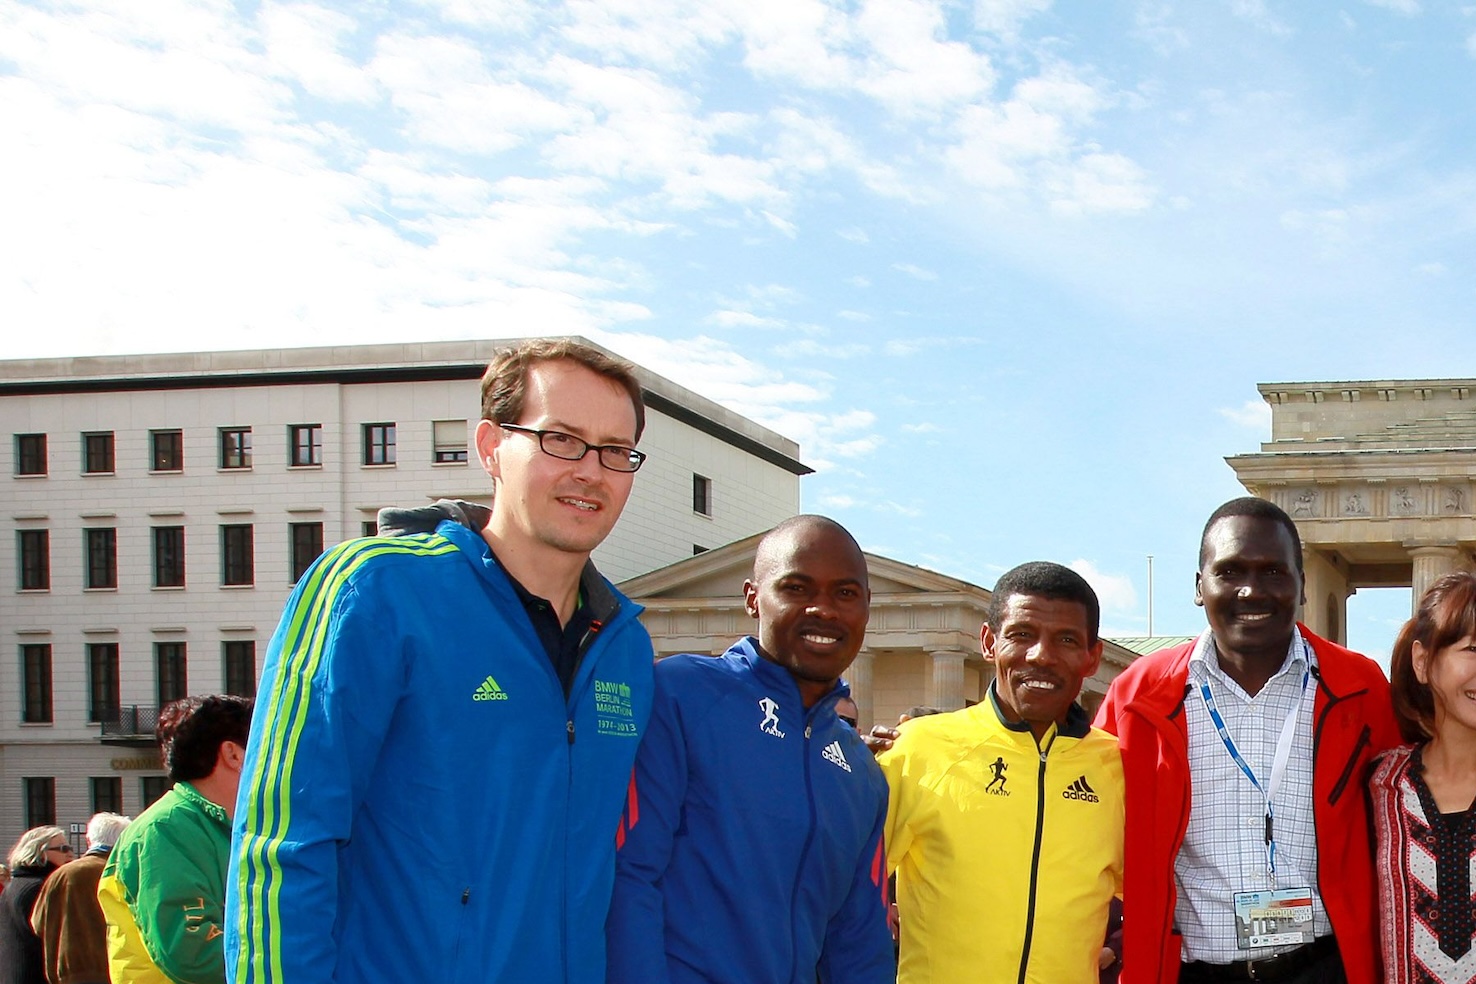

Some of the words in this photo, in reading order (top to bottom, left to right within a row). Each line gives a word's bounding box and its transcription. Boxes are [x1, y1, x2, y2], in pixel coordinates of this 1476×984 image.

[595, 680, 619, 694] BMW
[472, 691, 508, 701] adidas
[595, 693, 620, 704] BERLIN
[596, 703, 633, 717] MARATHON
[821, 749, 852, 773] adidas
[990, 788, 1011, 797] AKTIV
[1062, 790, 1100, 803] adidas
